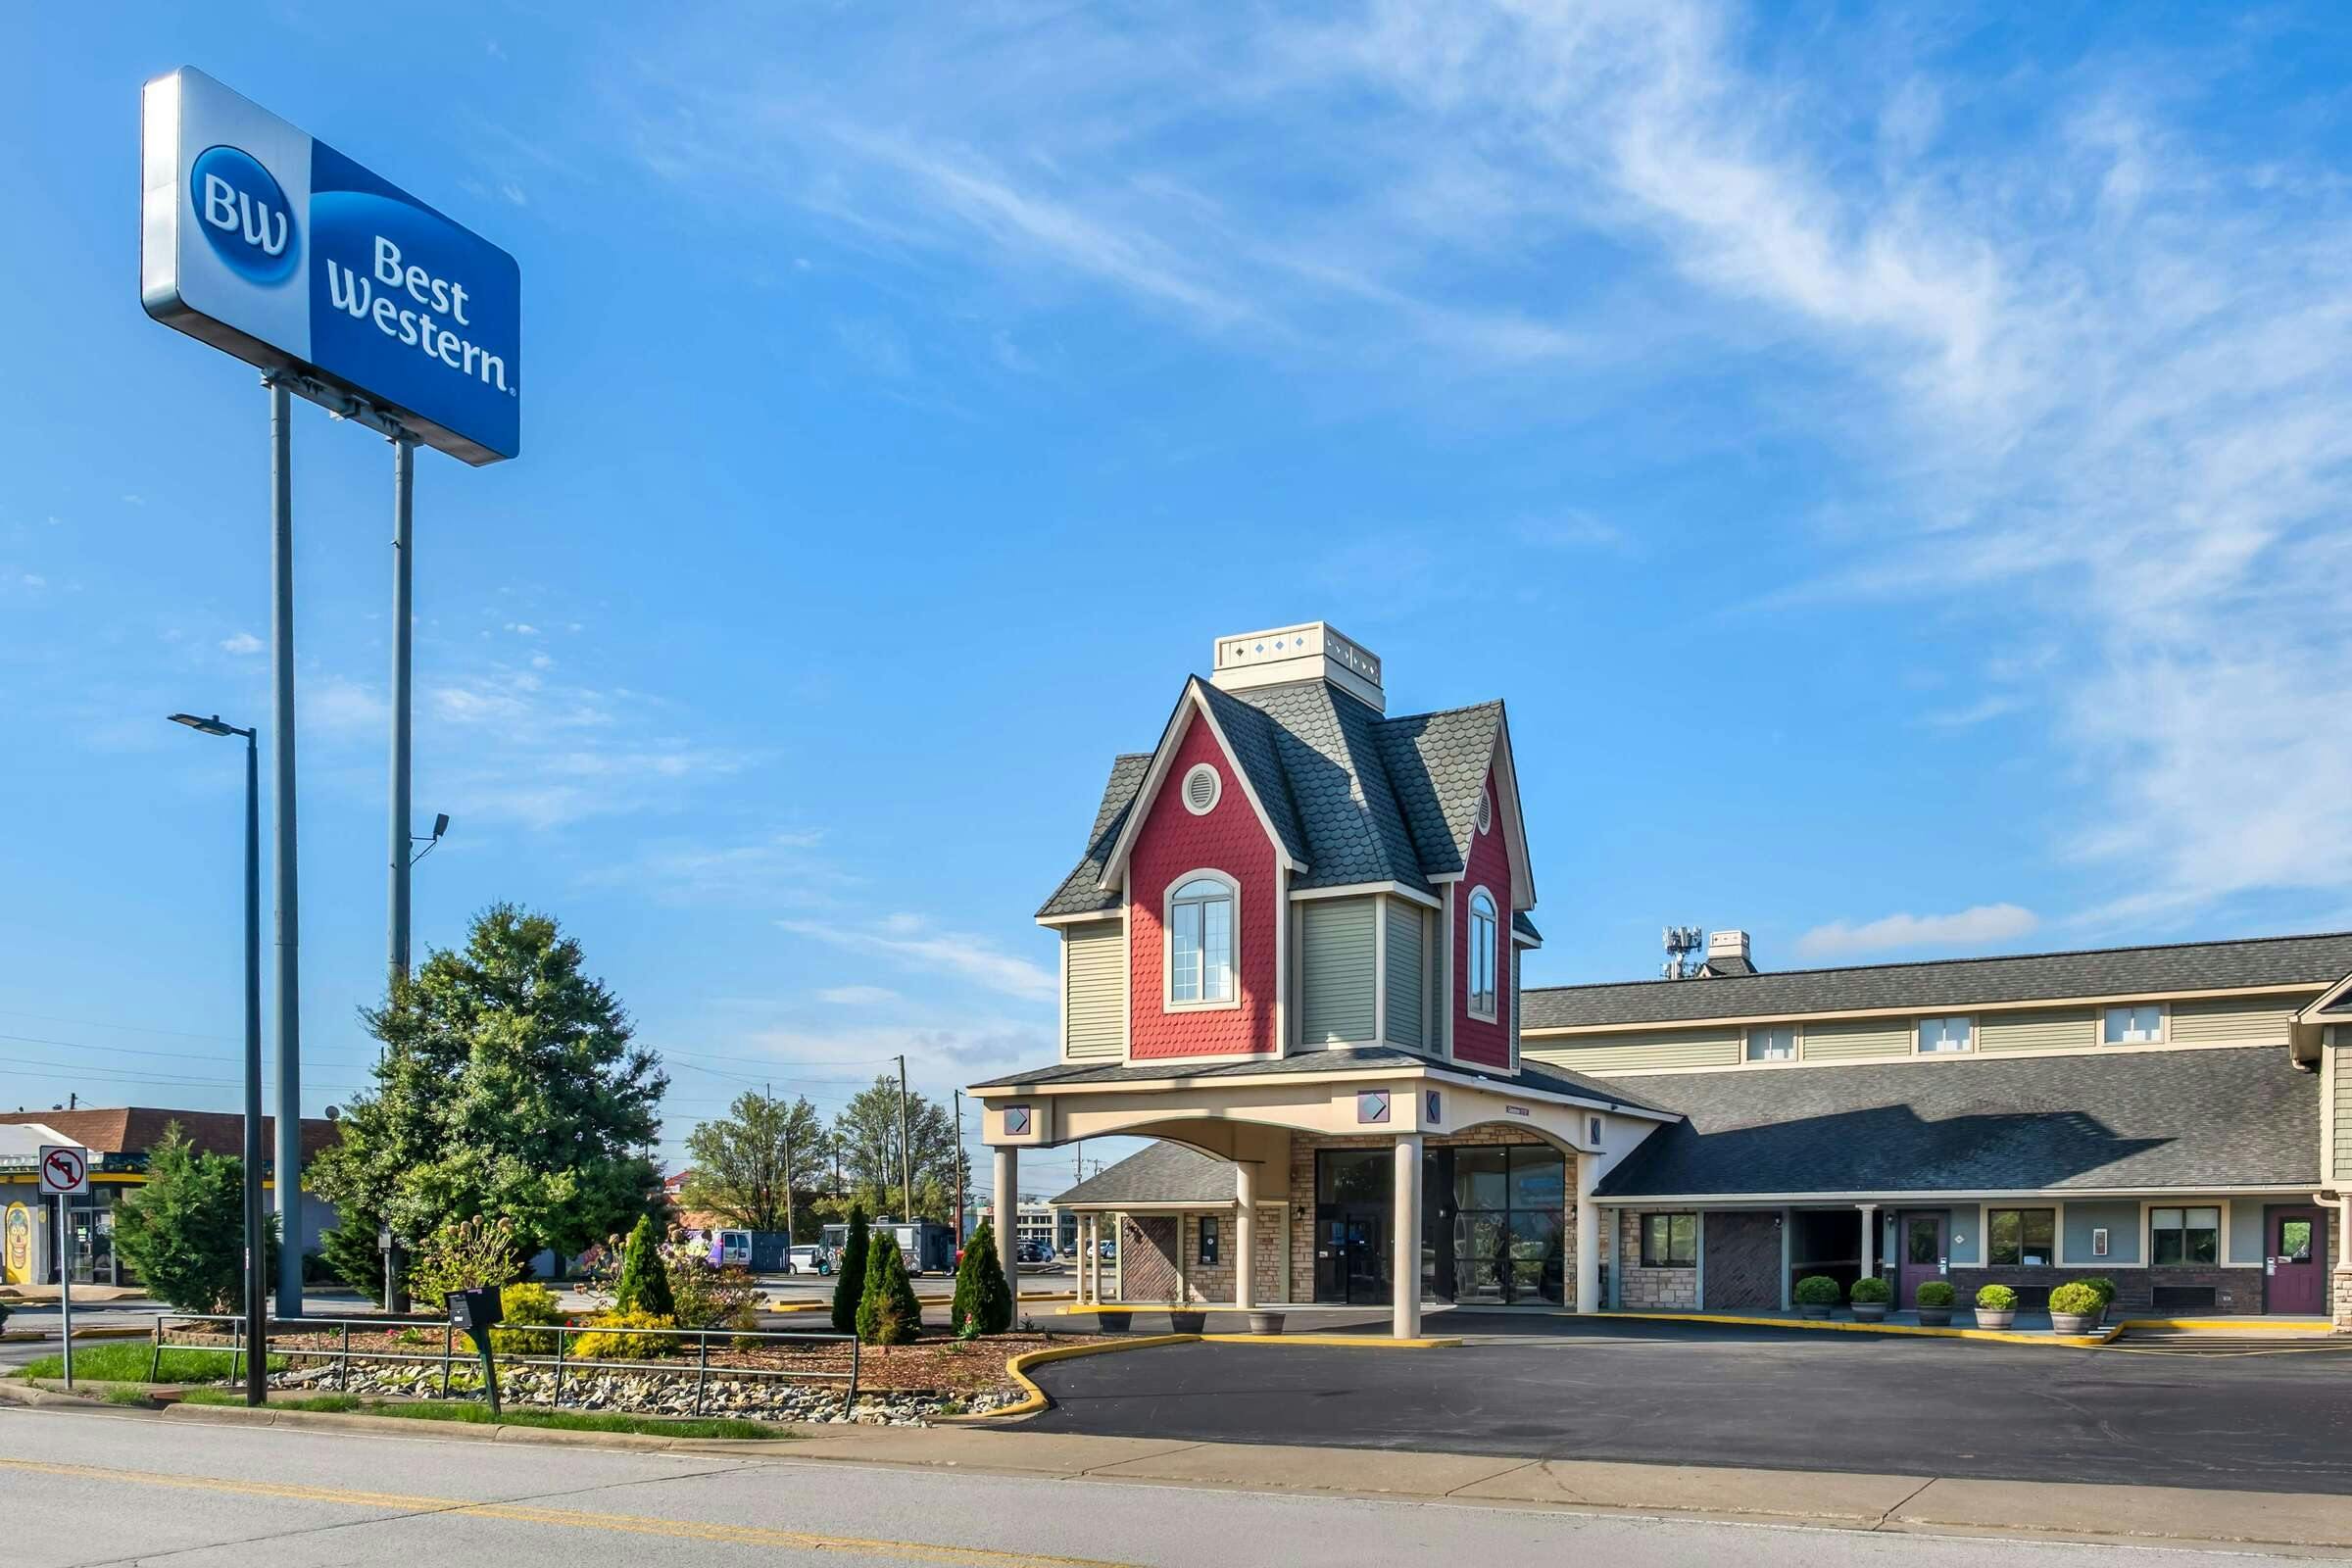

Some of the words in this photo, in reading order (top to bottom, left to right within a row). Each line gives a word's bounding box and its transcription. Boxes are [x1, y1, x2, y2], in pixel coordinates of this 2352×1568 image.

[205, 172, 288, 257] BW
[326, 259, 507, 392] Western
[374, 234, 469, 326] Best
